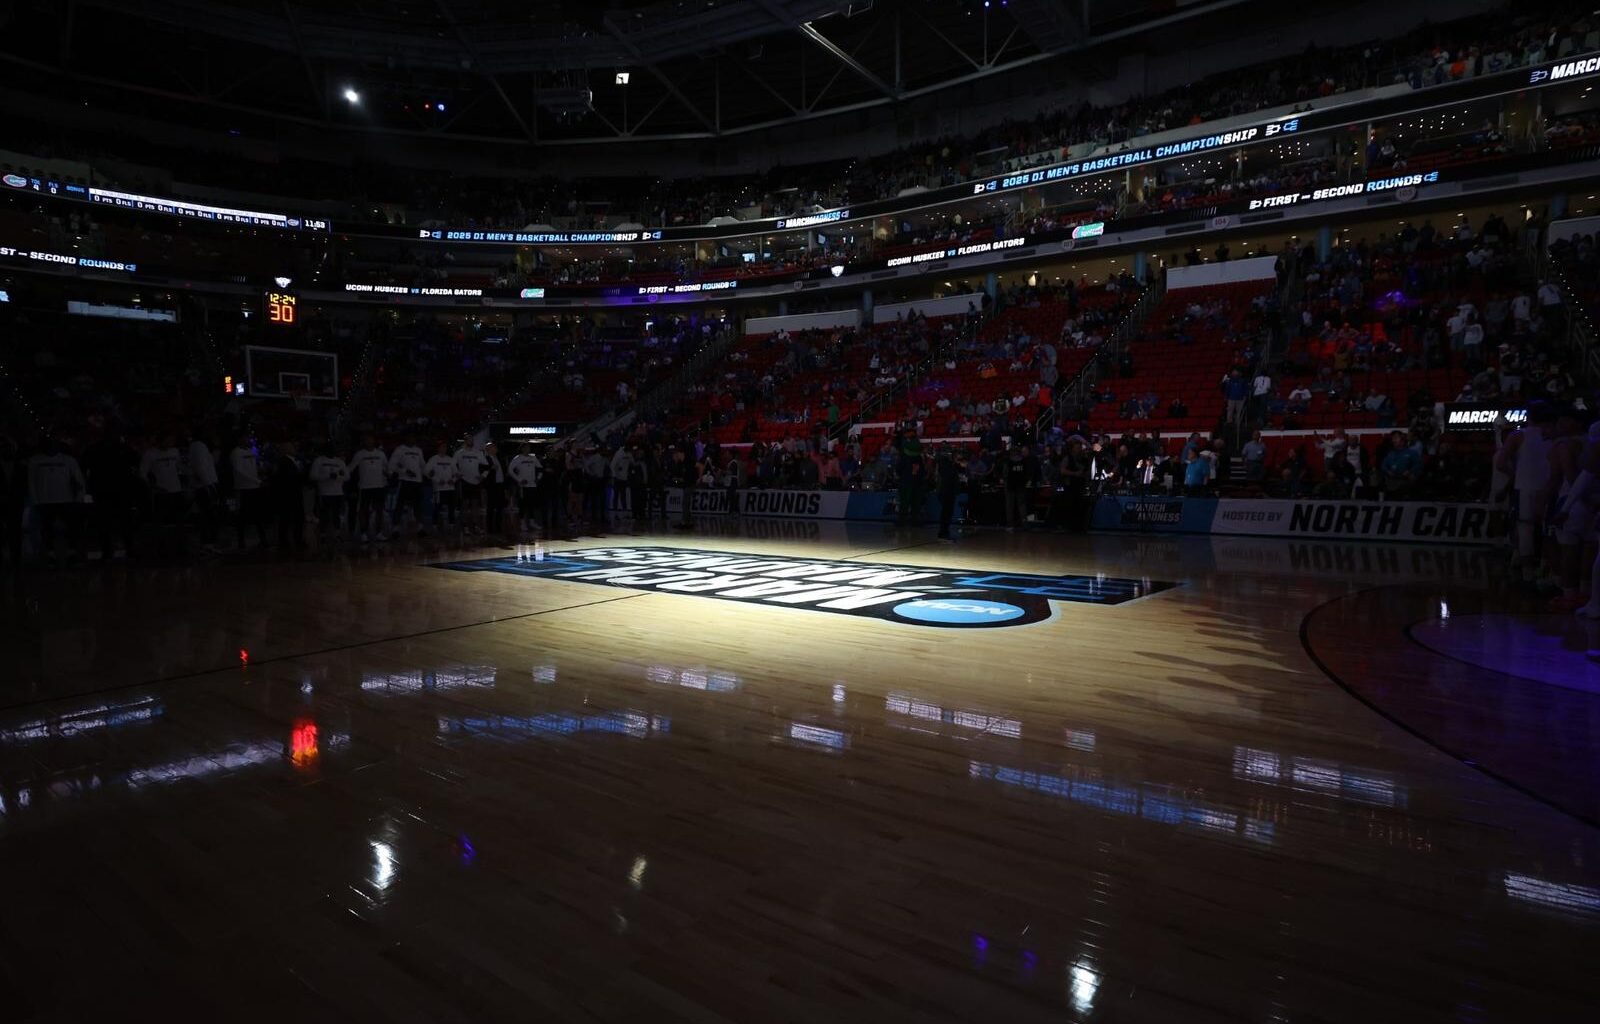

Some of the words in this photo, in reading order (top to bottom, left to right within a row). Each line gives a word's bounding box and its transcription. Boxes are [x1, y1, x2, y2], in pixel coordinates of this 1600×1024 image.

[1002, 175, 1029, 188] 2025
[1032, 172, 1045, 182] DI
[1047, 164, 1079, 179] MEN'S
[1082, 150, 1152, 171] BASKETBALL
[1156, 129, 1257, 157] CHAMPIONSHIP
[1263, 193, 1300, 207] FIRST
[1313, 184, 1363, 200] SECOND
[1367, 174, 1422, 192] ROUNDS
[447, 231, 471, 240] 2025
[473, 232, 484, 240] DI
[486, 233, 513, 241] MEN'S
[515, 233, 569, 242] BASKETBALL
[571, 233, 638, 242] CHAMPIONSHIP
[30, 251, 77, 265] SECOND
[79, 258, 125, 270] ROUNDS
[888, 256, 911, 267] UCONN
[912, 251, 945, 263] HUSKIES
[958, 243, 991, 255] FLORIDA
[993, 237, 1025, 250] GATORS
[345, 283, 373, 292] UCONN
[374, 285, 408, 294] HUSKIES
[454, 288, 482, 296] GATORS
[647, 286, 668, 294] FIRST
[675, 283, 701, 292] SECOND
[702, 281, 729, 290] ROUNDS
[269, 293, 296, 305] 12:24
[270, 303, 293, 322] 30
[1448, 410, 1499, 424] MARCH
[690, 494, 735, 512] ECON
[744, 492, 821, 514] ROUNDS
[1222, 510, 1264, 522] HOSTED
[1266, 512, 1283, 523] BY
[1288, 503, 1404, 534] NORTH
[550, 548, 941, 586] MADNESS
[555, 566, 928, 610] MARCH
[910, 600, 1017, 616] NCAA
